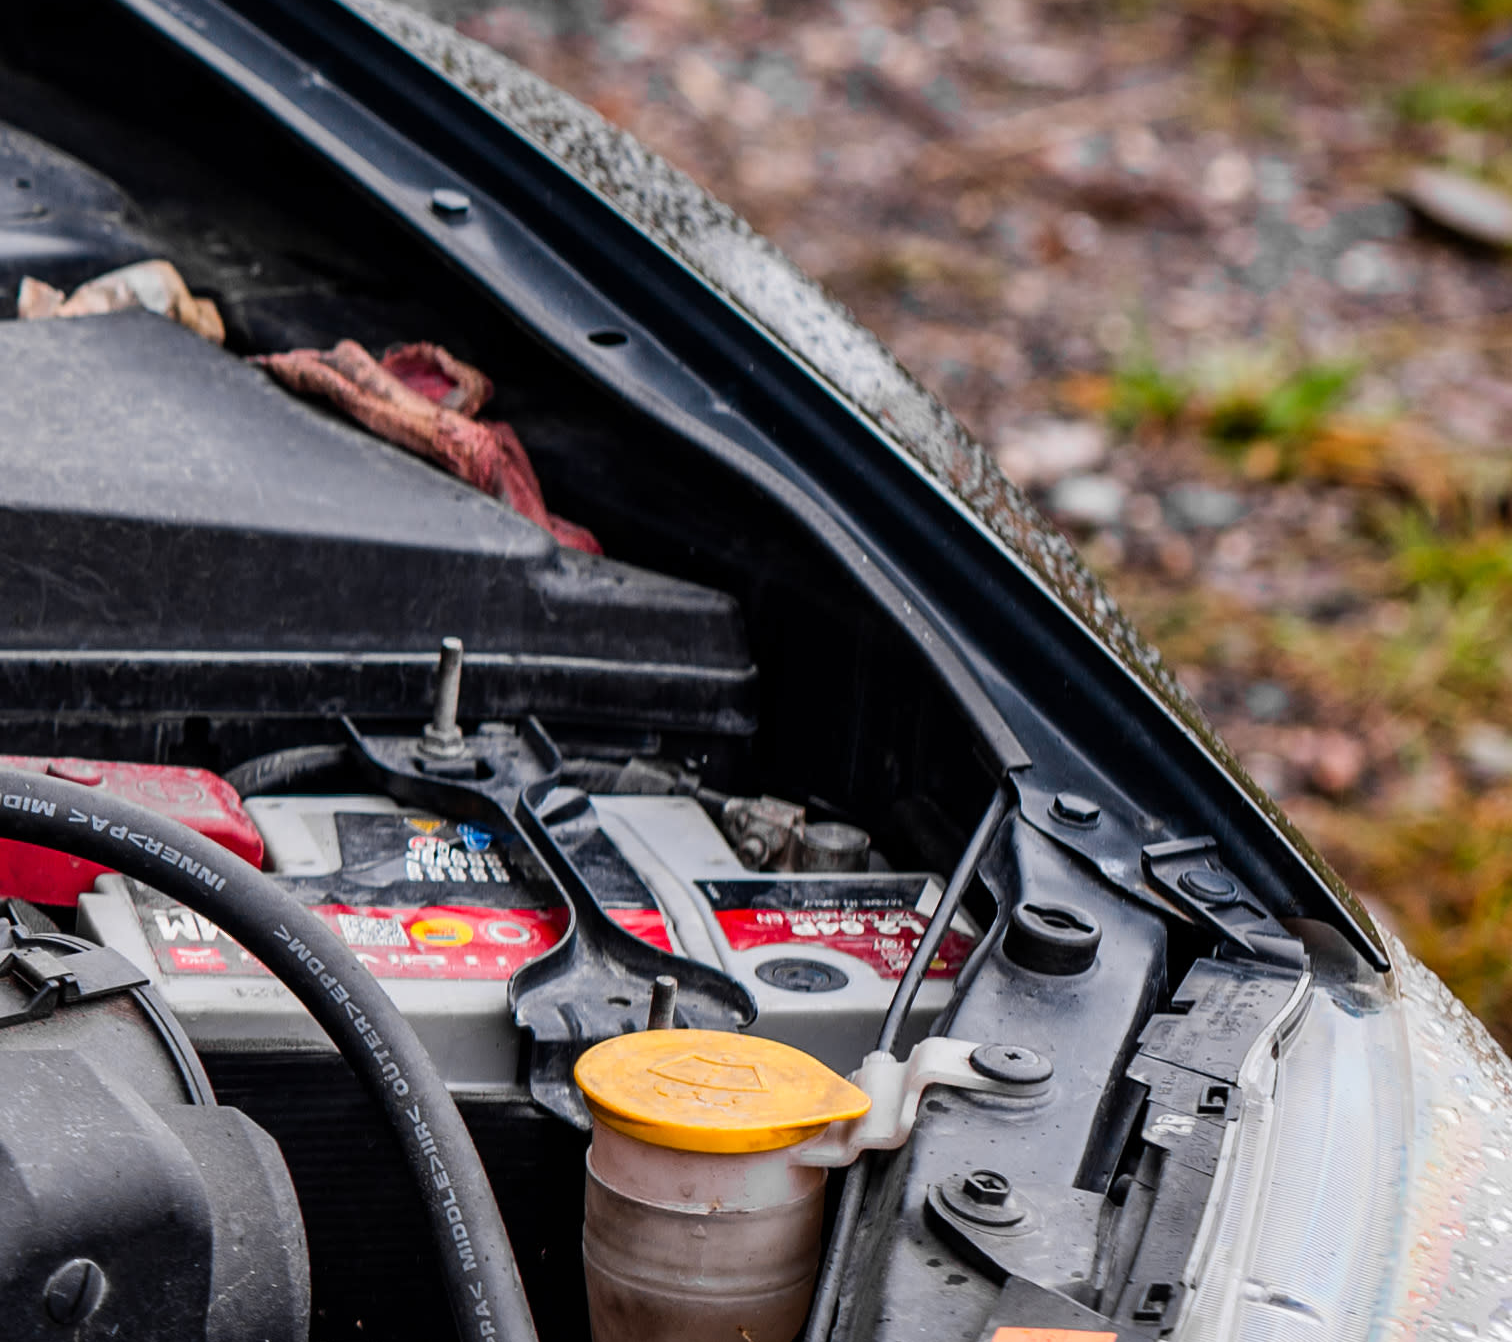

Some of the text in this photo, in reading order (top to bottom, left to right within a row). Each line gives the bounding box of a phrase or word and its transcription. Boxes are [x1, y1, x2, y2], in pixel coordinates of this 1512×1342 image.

[68, 808, 227, 892] INNER>PA<
[273, 924, 409, 1097] OUTER>EPDM<
[406, 1104, 478, 1272] MIDDLE>IIR<
